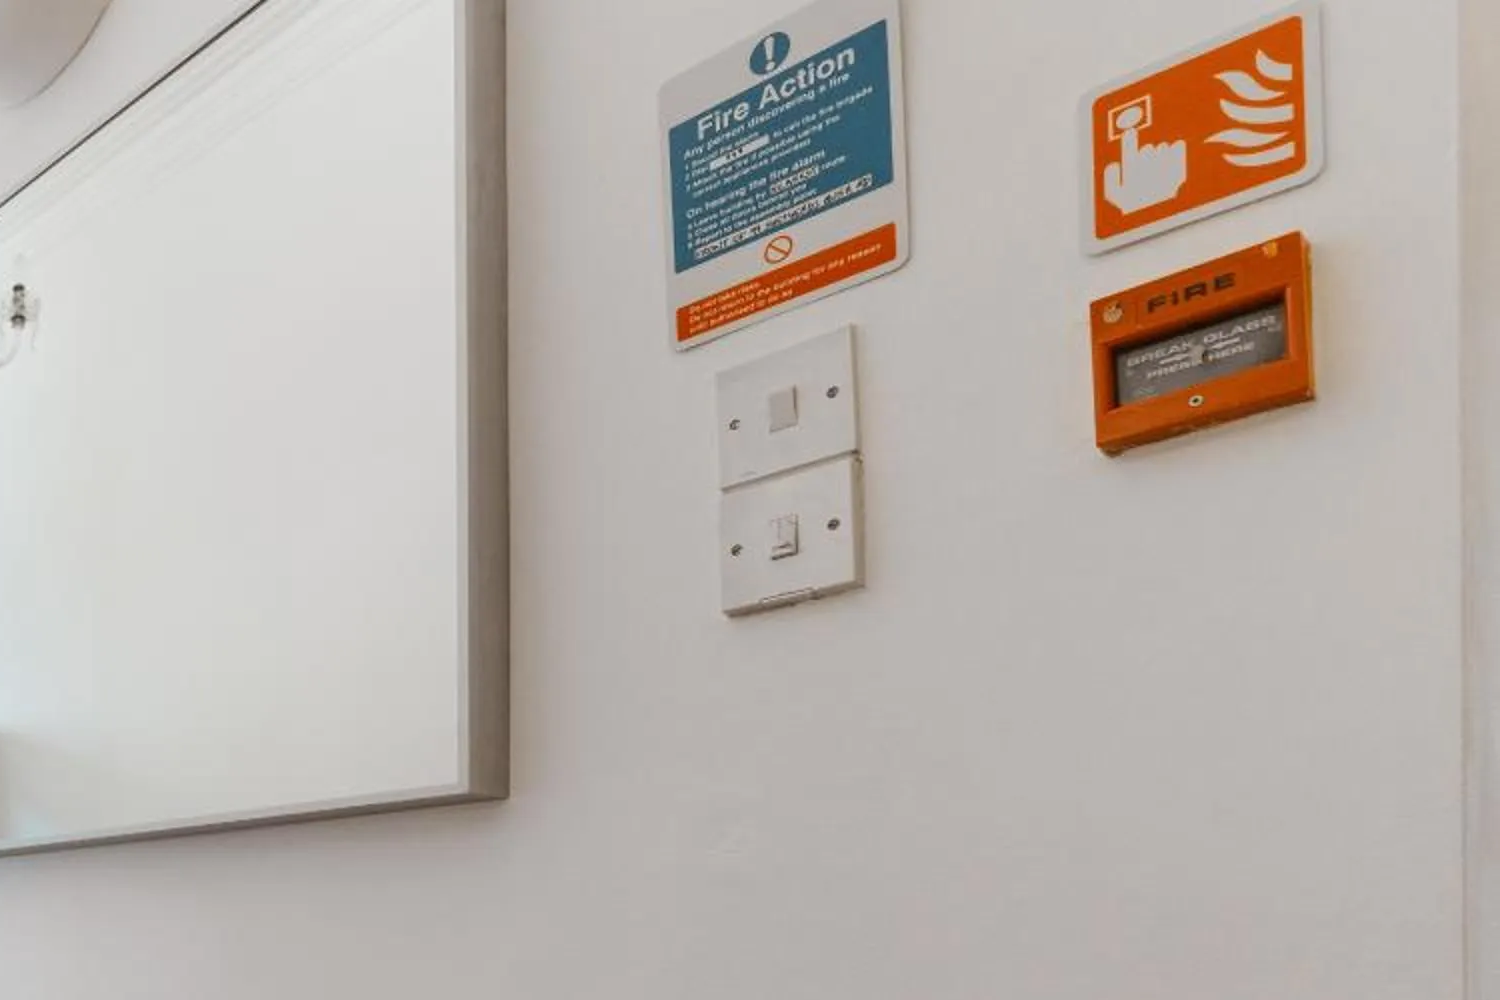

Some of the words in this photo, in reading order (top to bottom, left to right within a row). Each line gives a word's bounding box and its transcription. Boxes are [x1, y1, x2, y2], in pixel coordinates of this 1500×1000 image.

[697, 101, 750, 141] Fire
[757, 47, 855, 111] Action
[1148, 272, 1235, 313] FIRE
